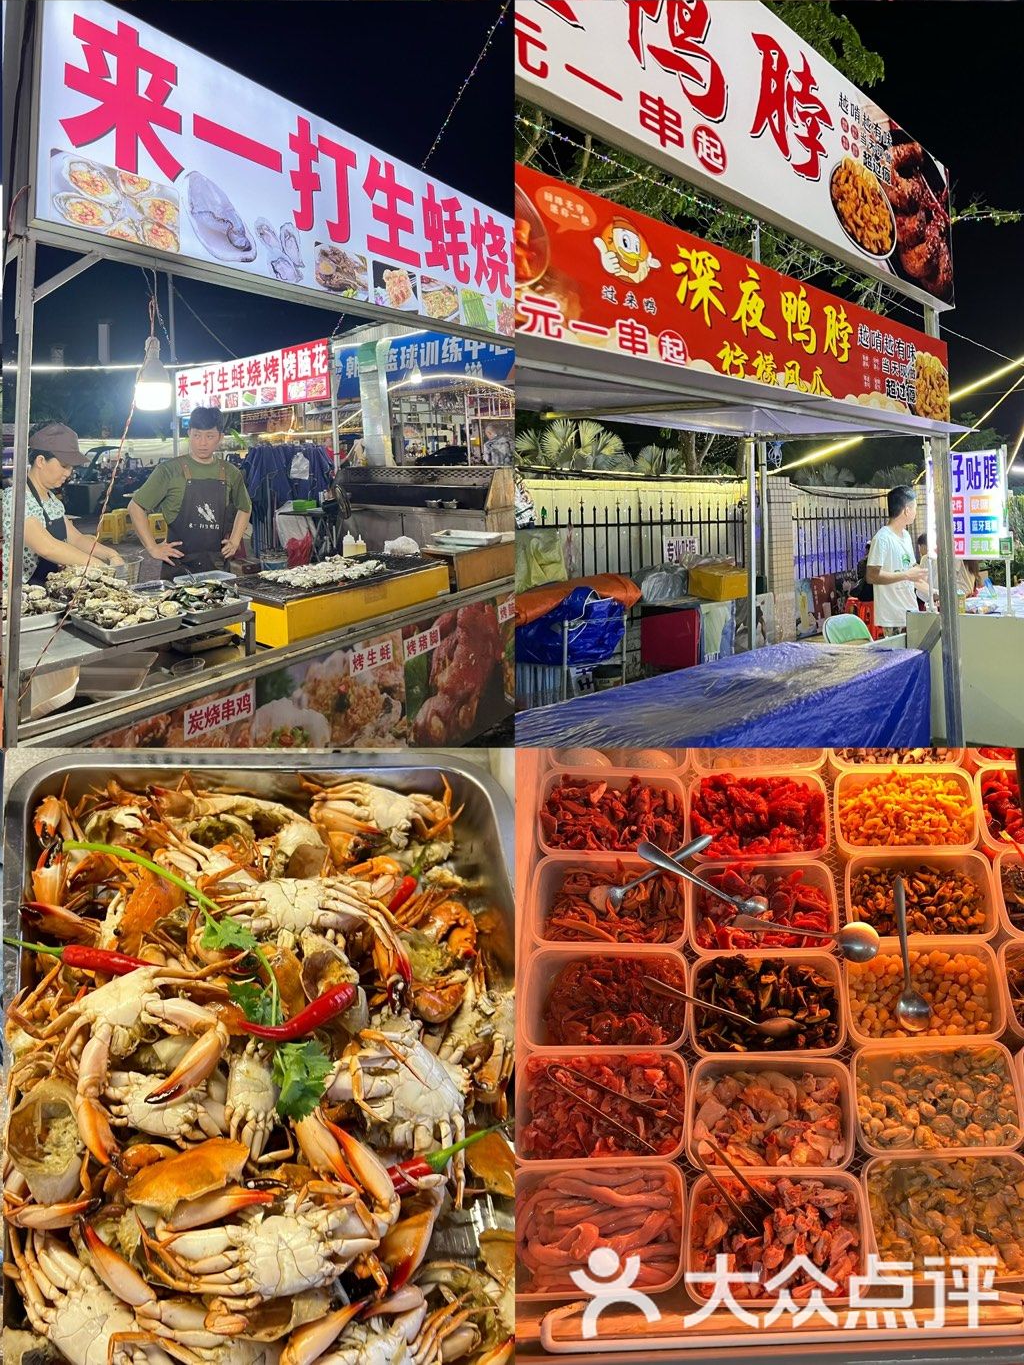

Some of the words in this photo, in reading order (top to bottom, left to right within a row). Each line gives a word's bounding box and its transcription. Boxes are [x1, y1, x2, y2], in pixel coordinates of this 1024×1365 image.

[59, 13, 514, 299] 来一打生蚝烧
[671, 244, 853, 364] 深夜鸭脖
[178, 357, 280, 398] 来一打生蚝烧烤
[351, 642, 392, 673] 烤生蚝
[406, 629, 440, 659] 烤猪脚
[188, 692, 252, 736] 炭烧串鸡
